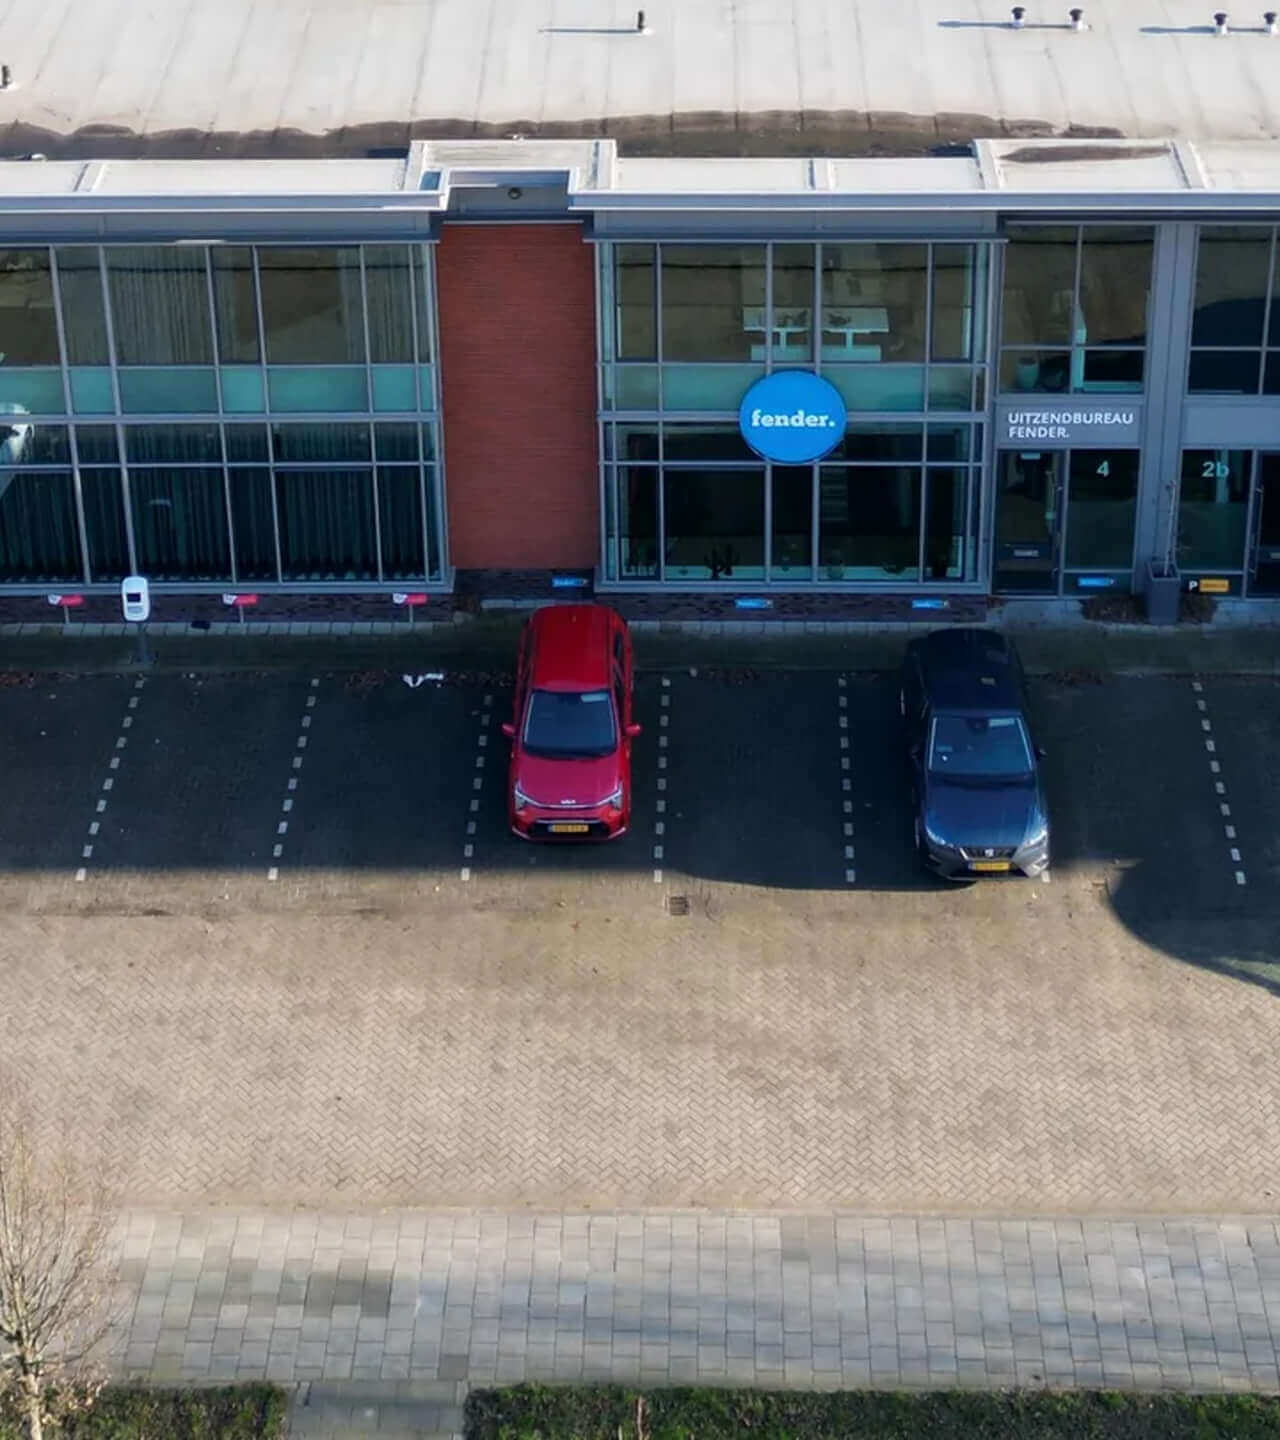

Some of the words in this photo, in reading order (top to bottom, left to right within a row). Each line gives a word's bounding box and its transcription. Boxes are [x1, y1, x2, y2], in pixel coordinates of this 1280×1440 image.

[751, 408, 836, 428] fender.
[1007, 411, 1134, 425] UITZENDBUREAU
[1007, 426, 1071, 439] FENDER.
[1096, 461, 1110, 477] 4
[1201, 461, 1230, 478] 2b
